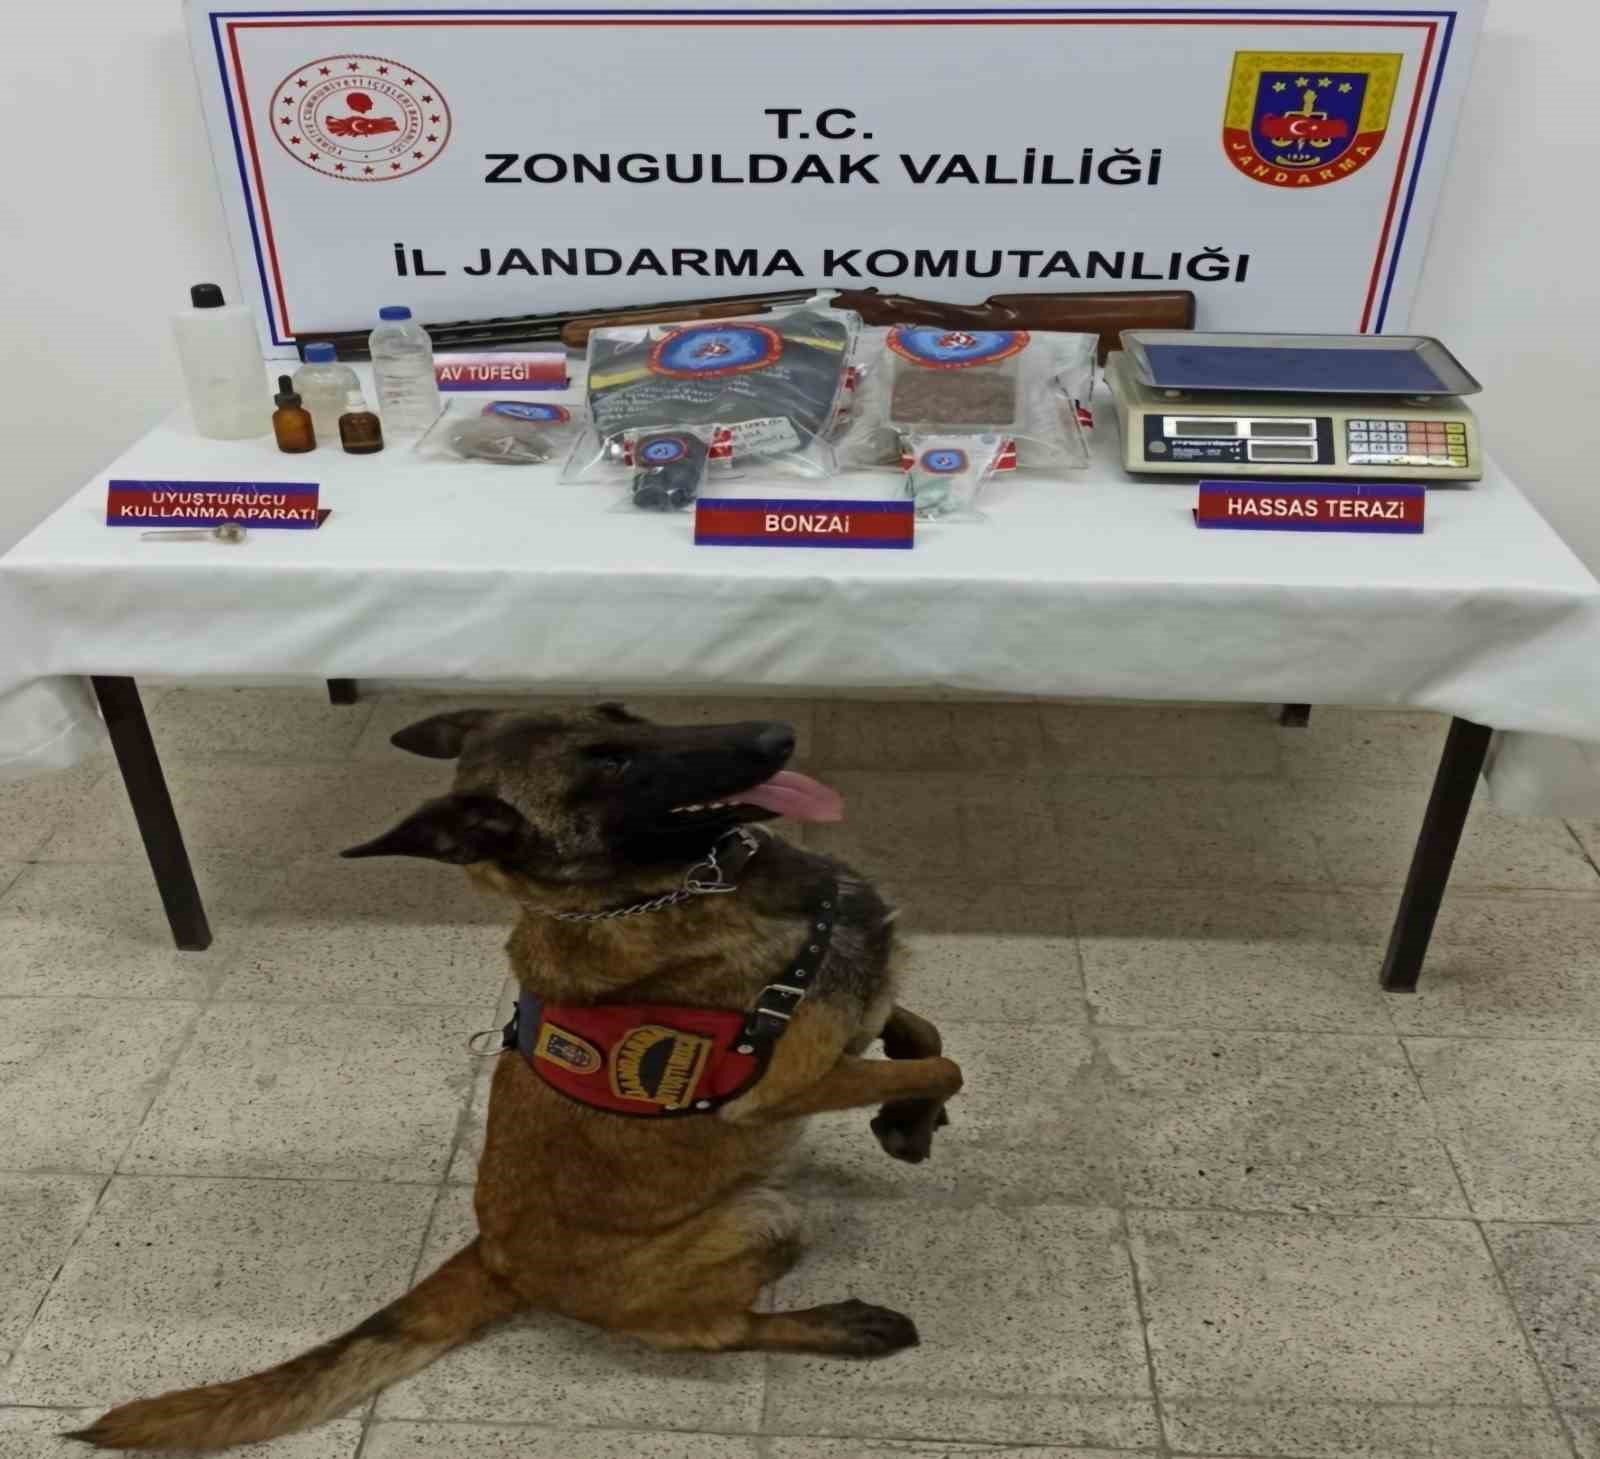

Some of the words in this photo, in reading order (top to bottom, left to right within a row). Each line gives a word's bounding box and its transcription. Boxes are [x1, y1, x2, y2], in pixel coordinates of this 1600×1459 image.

[765, 108, 873, 140] T.C.
[484, 153, 880, 184] ZONGULDAK
[900, 147, 1162, 186] VALİLİĞİ
[1232, 142, 1372, 184] JANDARMA
[394, 243, 446, 277] İL
[463, 247, 804, 278] JANDARMA
[823, 246, 1250, 283] KOMUTANLIĞI
[440, 367, 462, 381] AV
[152, 492, 287, 506] UYUŞTURUCU
[1227, 497, 1318, 517] HASSAS
[120, 505, 229, 519] KULLANMA
[233, 507, 316, 521] APARATI
